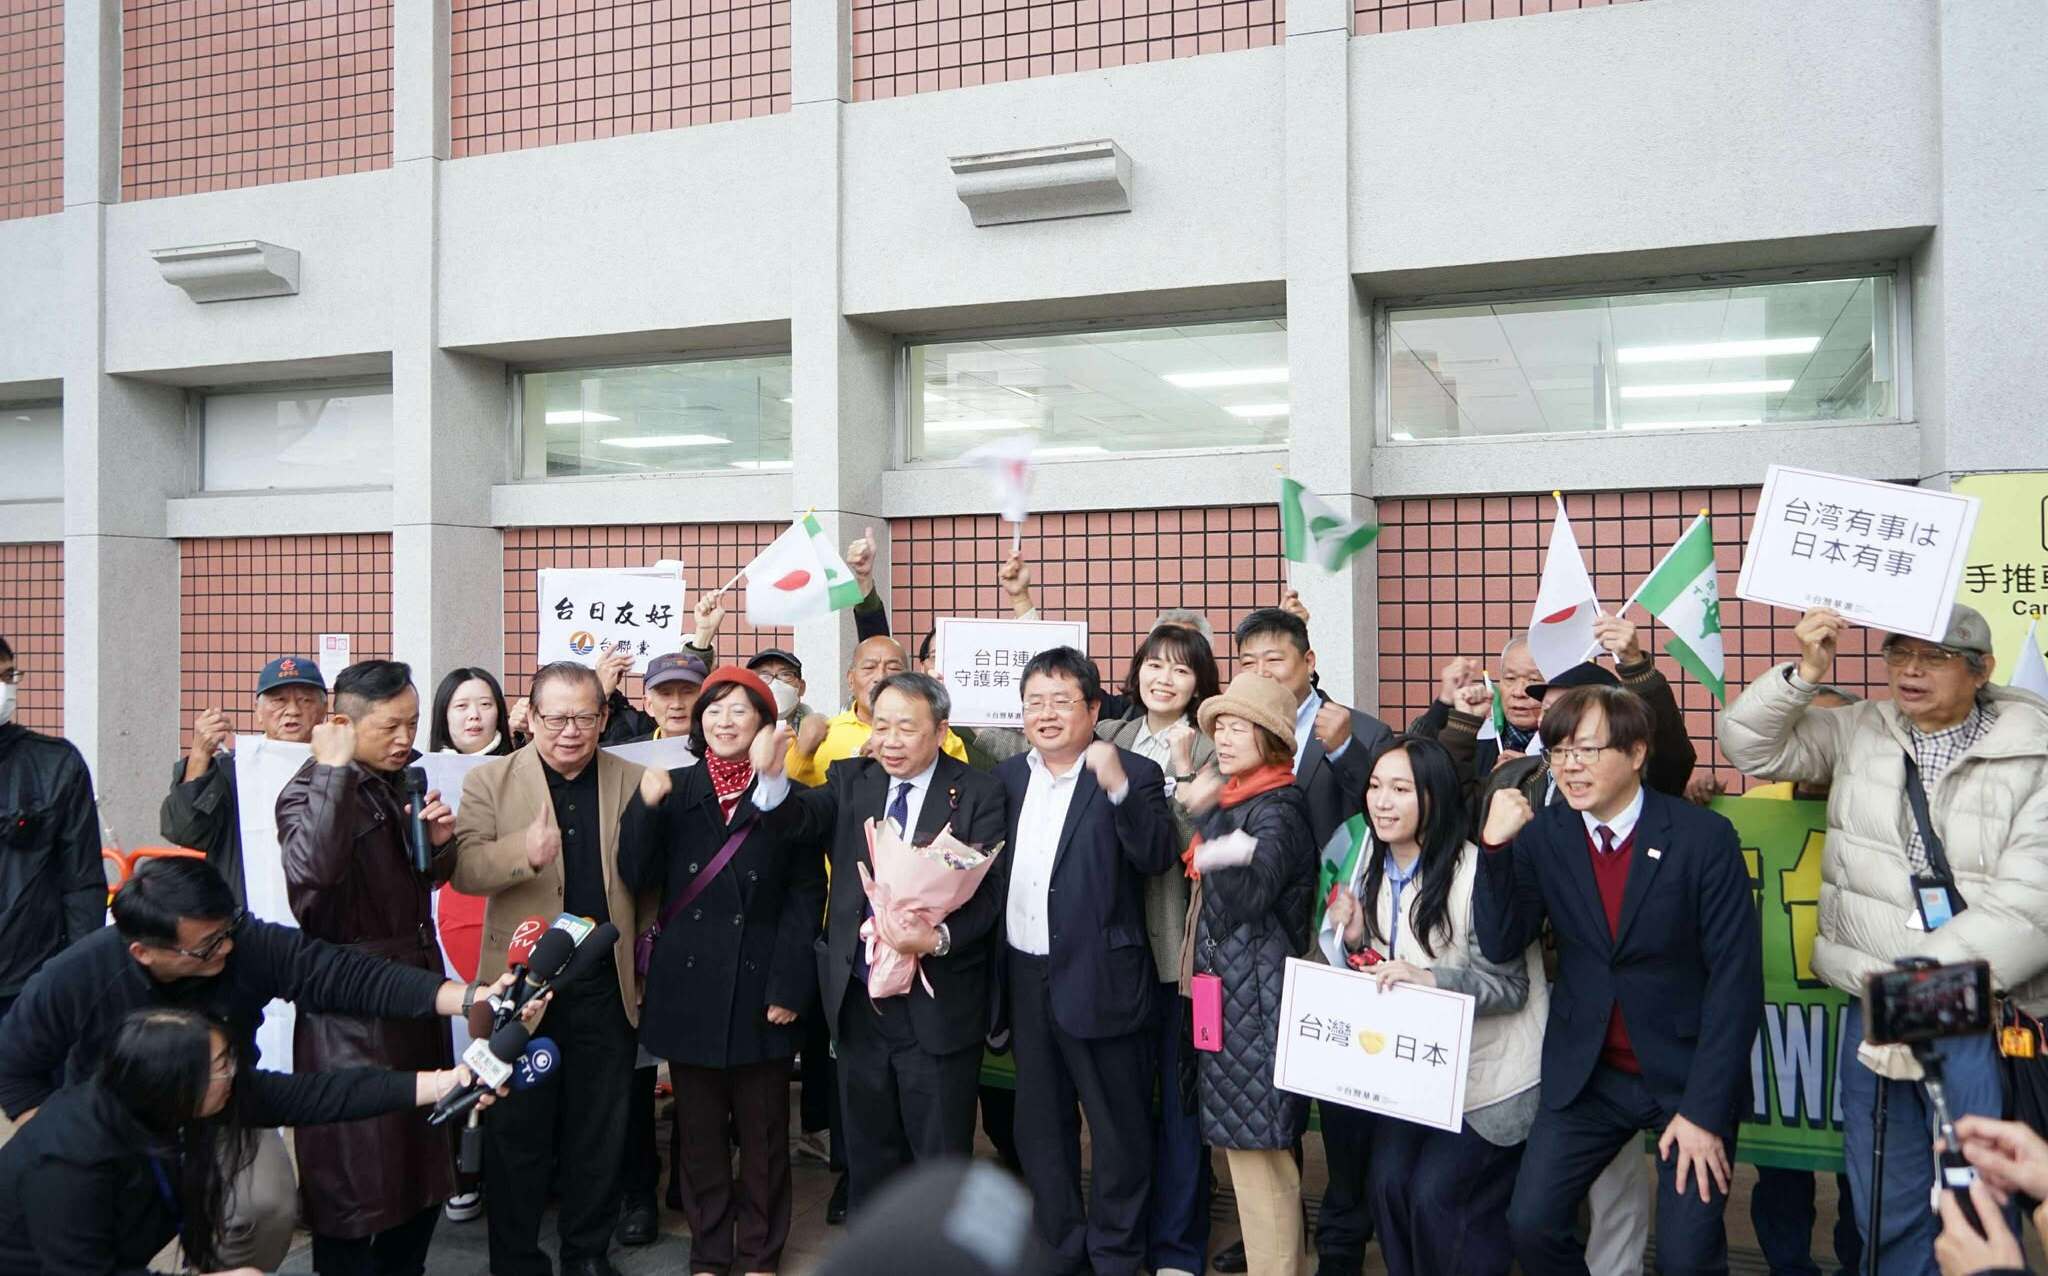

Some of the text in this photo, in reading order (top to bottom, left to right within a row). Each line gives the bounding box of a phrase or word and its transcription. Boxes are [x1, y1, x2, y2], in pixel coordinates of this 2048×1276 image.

[1783, 497, 1940, 547] 台湾有事は
[1791, 531, 1917, 577] 日本有事
[1965, 563, 2048, 594] 手推
[554, 596, 675, 629] 台日友好
[975, 649, 1042, 667] 台日連
[1300, 1013, 1449, 1068] 台灣 日本
[516, 1054, 535, 1083] FTV
